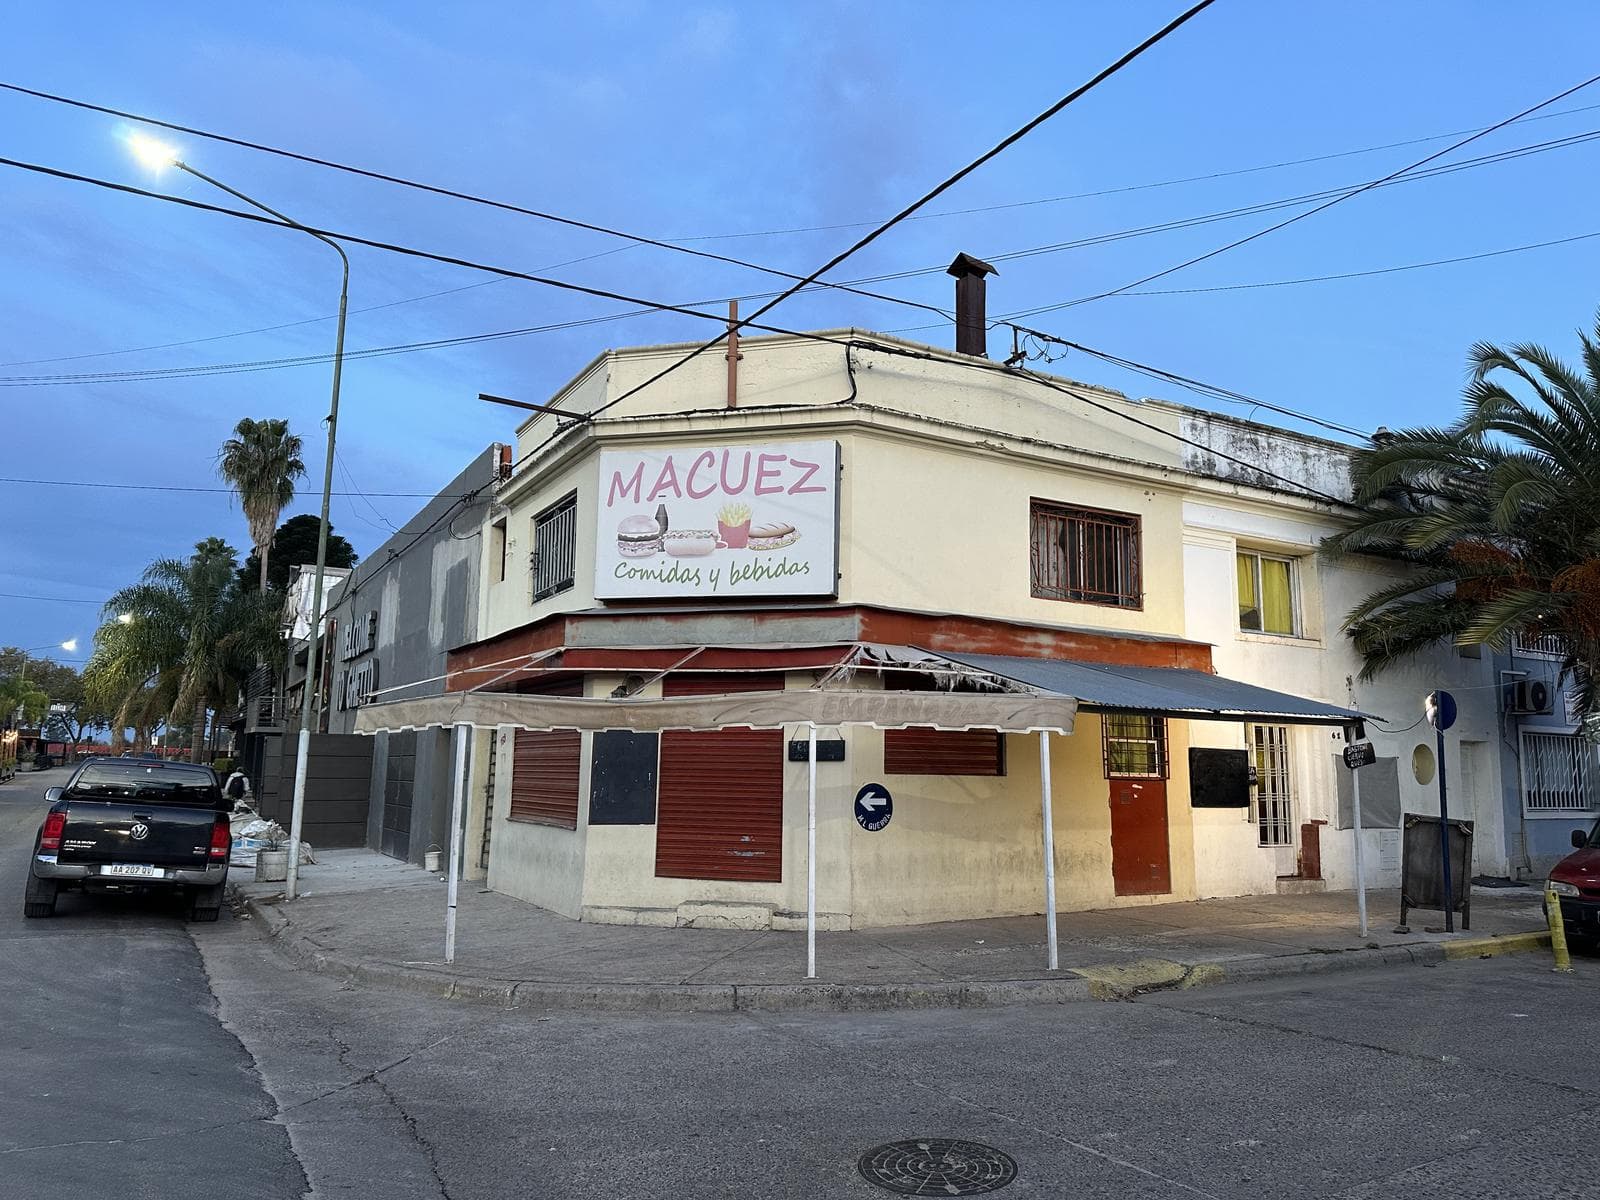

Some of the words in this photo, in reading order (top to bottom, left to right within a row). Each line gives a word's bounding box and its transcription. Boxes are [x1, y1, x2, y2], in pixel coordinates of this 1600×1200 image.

[607, 449, 827, 507] MACUEZ
[614, 560, 701, 587] Comidas
[709, 568, 721, 591] y
[730, 557, 810, 586] bebidas
[868, 814, 891, 830] GUERRA
